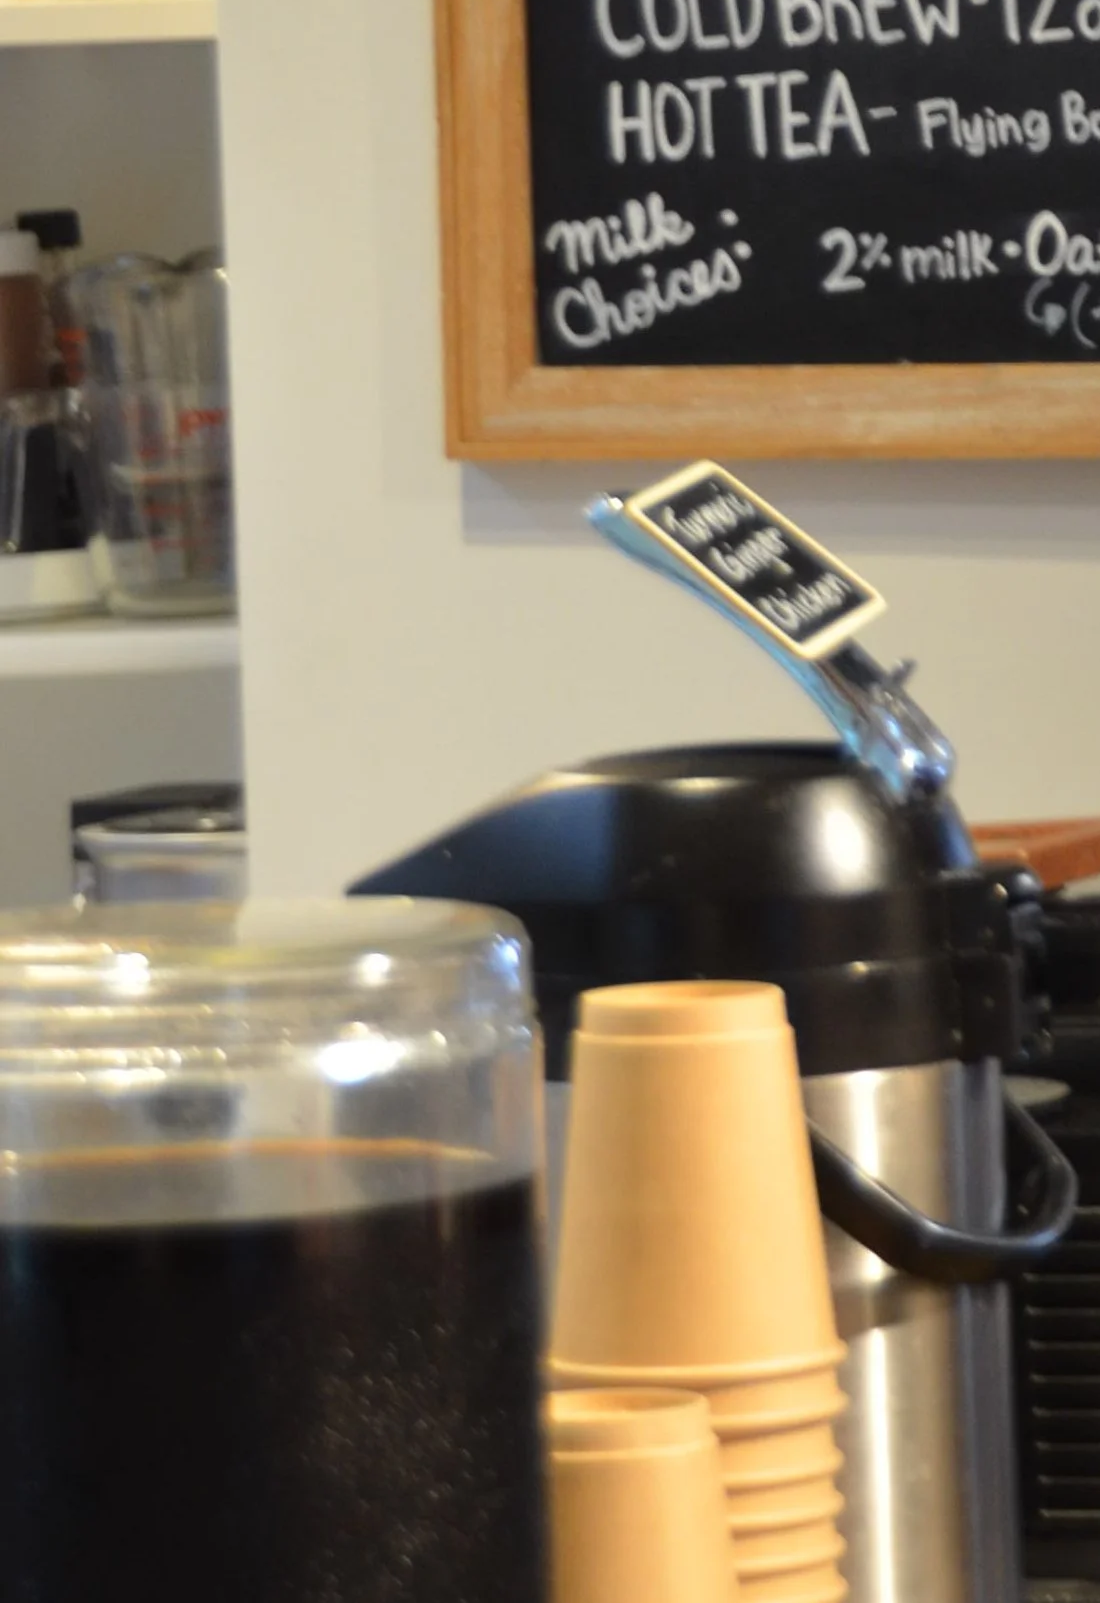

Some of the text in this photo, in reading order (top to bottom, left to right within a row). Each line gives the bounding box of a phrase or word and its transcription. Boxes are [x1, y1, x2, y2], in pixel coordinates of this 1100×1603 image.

[607, 76, 726, 164] HOT
[736, 69, 870, 160] TEA
[917, 97, 1051, 156] Flying
[820, 226, 893, 293] 2%
[900, 230, 1000, 284] milk
